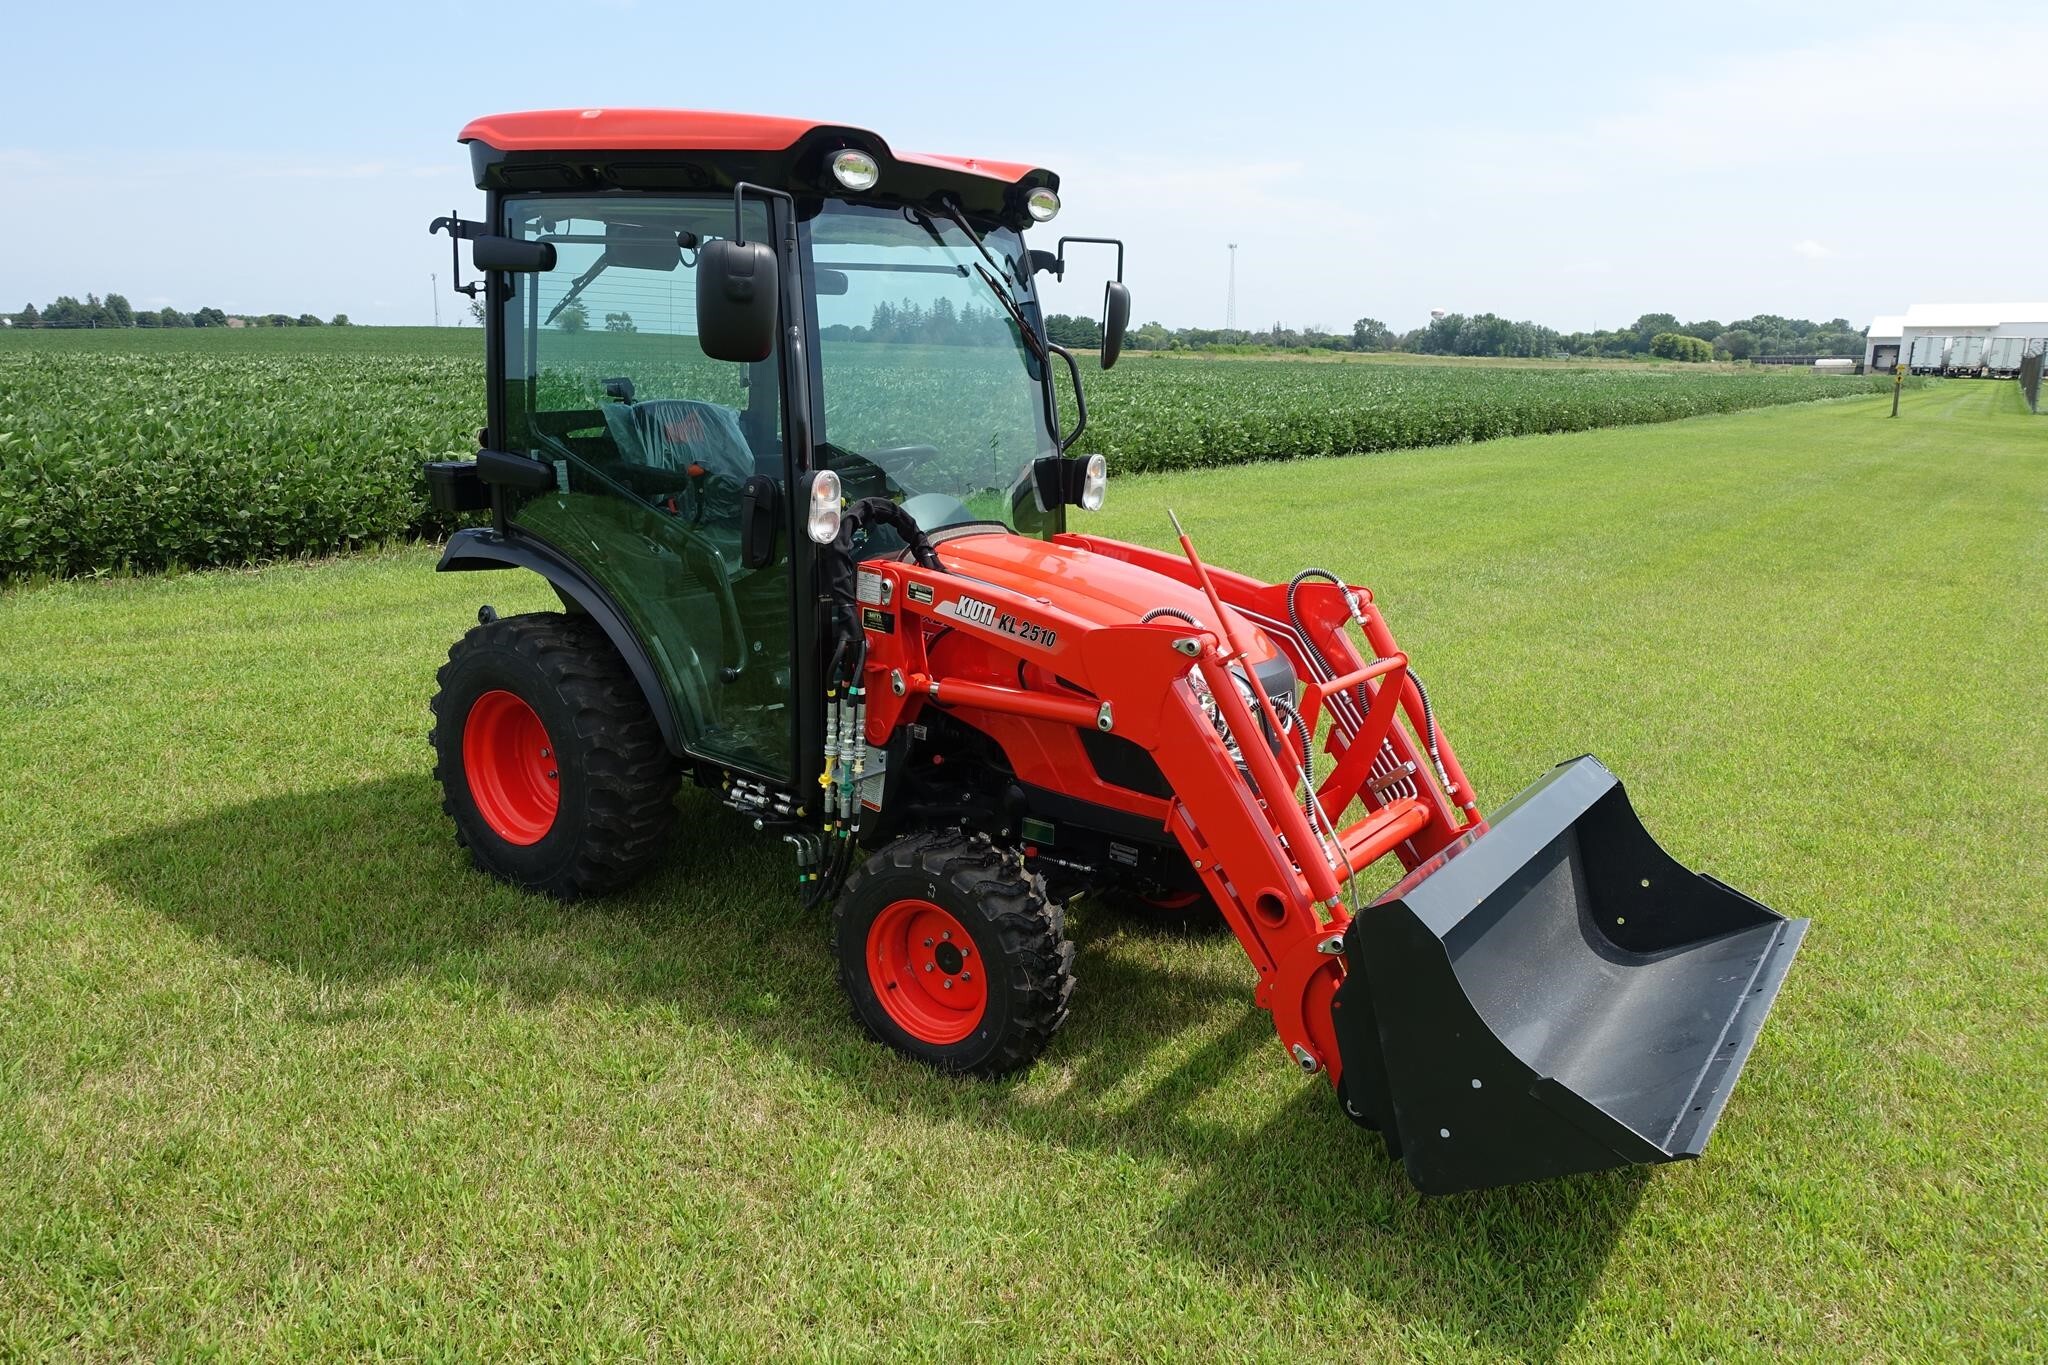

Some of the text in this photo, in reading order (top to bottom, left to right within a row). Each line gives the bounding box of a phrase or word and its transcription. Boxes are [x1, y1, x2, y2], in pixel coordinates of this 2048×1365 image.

[955, 595, 997, 626] KIOTI
[999, 614, 1016, 634] KL
[1020, 621, 1057, 647] 2510
